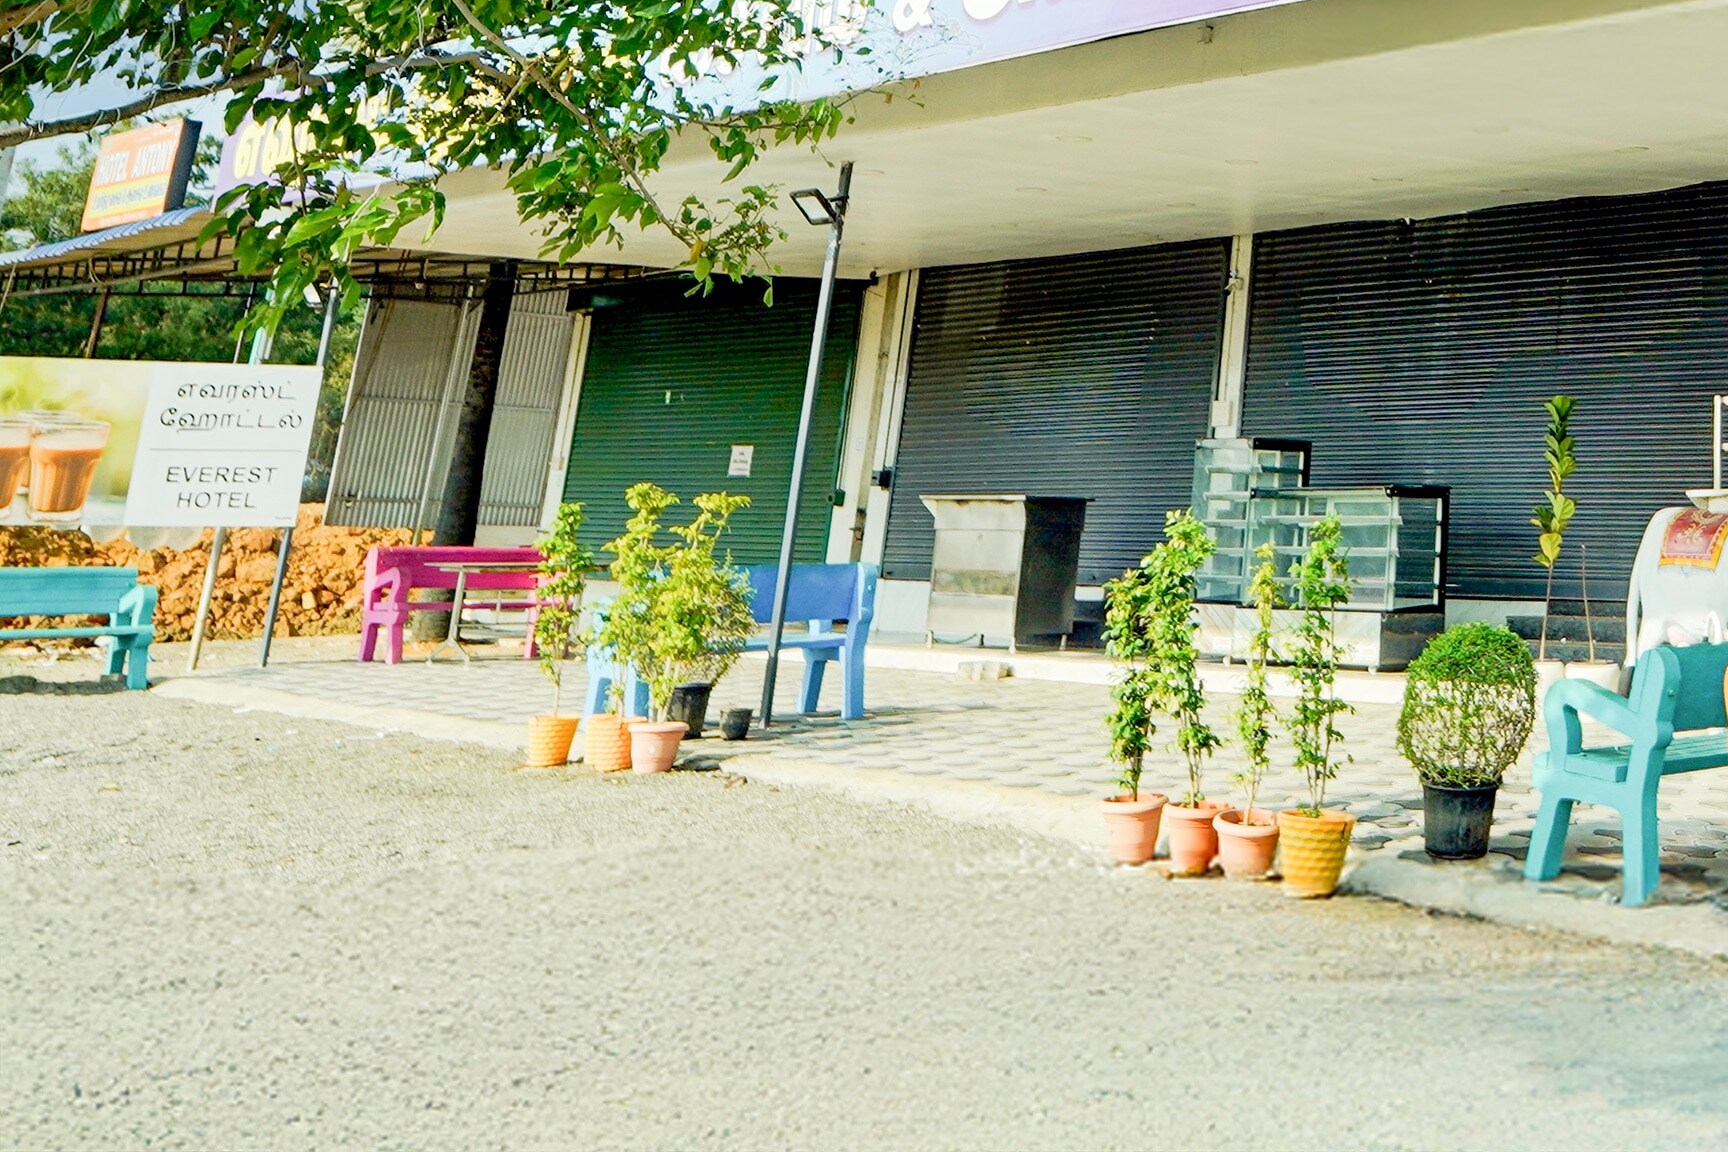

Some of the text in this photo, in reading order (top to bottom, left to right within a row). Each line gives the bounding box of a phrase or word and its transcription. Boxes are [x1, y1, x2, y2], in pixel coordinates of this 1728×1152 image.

[177, 380, 297, 403] எவரஸ்ட்
[160, 407, 303, 435] ஹோட்டல்
[166, 466, 278, 484] EVEREST
[176, 491, 257, 509] HOTEL
